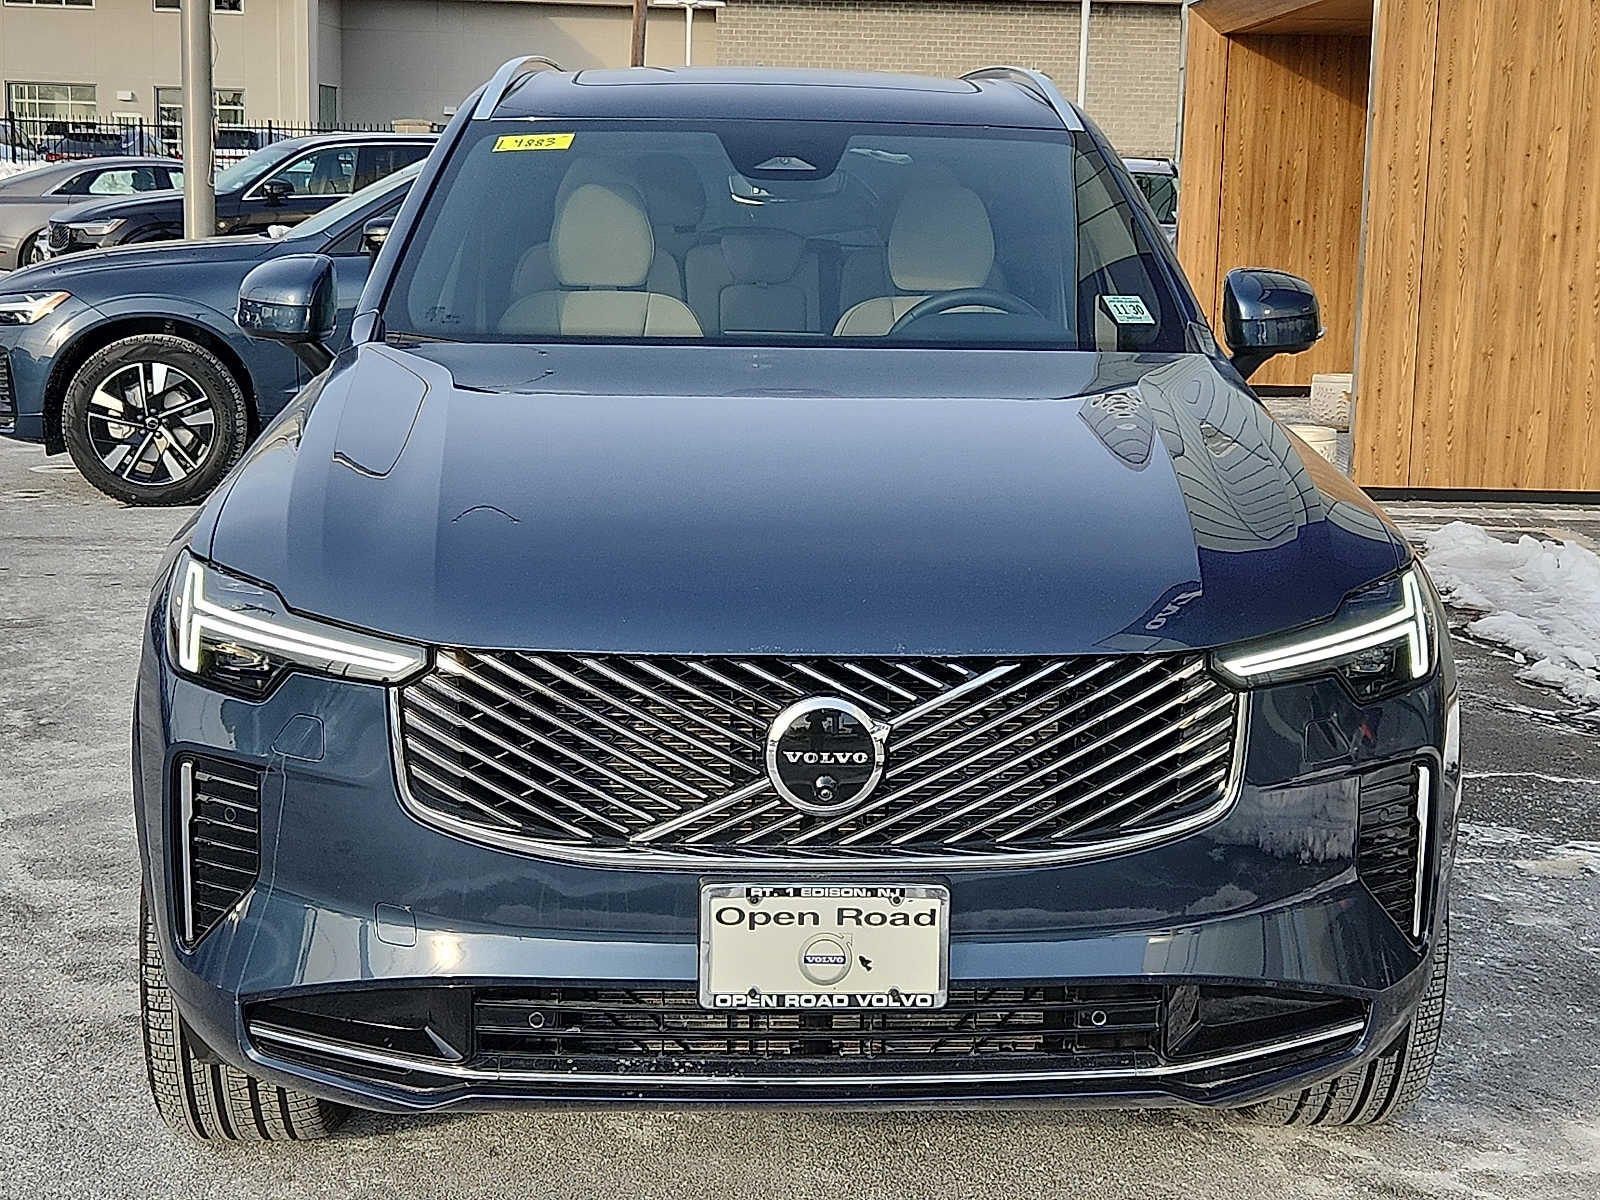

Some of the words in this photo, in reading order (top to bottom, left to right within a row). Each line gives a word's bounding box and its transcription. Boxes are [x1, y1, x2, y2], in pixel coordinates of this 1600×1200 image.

[514, 137, 556, 147] 4883
[1113, 304, 1130, 315] 11
[782, 750, 869, 764] VOLVO
[750, 887, 778, 897] RT.
[785, 887, 795, 897] 1
[877, 887, 901, 898] NJ
[715, 907, 820, 931] Open
[836, 907, 937, 927] Road
[804, 955, 846, 964] VOLVO
[714, 994, 778, 1008] OPEN
[784, 994, 849, 1008] ROAD
[855, 994, 933, 1008] VOLVO
